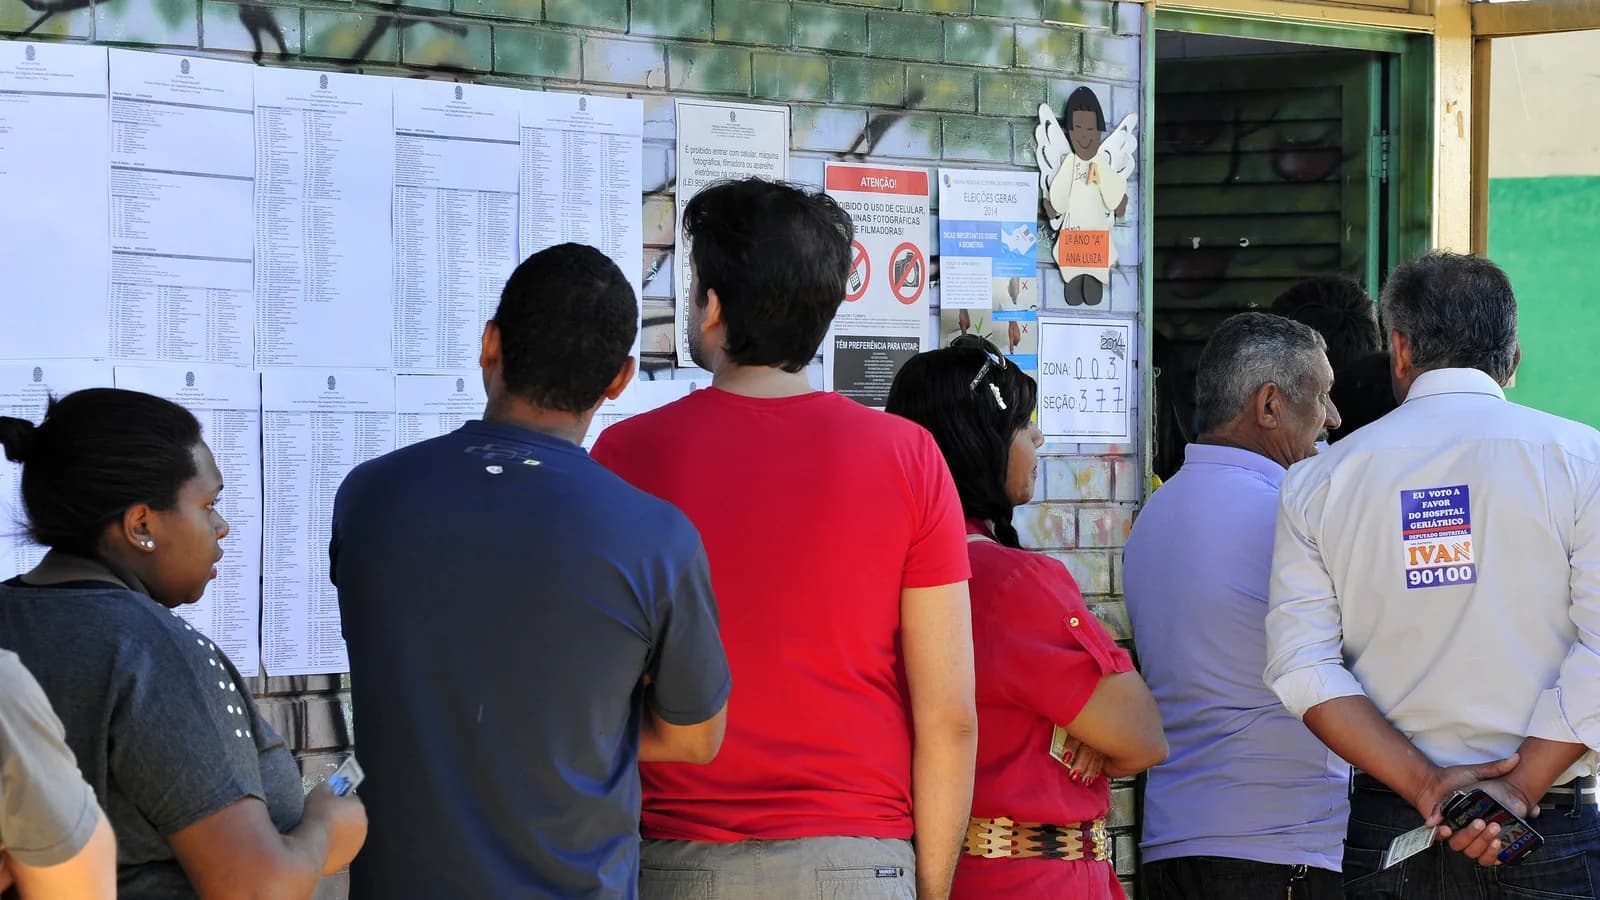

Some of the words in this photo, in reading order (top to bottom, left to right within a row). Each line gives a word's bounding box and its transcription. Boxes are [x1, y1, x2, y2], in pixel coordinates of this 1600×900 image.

[690, 147, 712, 156] proibido
[740, 150, 758, 159] celular,
[759, 151, 780, 160] máquina
[693, 157, 720, 168] fotográfica,
[722, 158, 746, 168] filmadora
[753, 162, 774, 170] aparelho
[694, 168, 720, 177] eletrônico
[860, 176, 896, 190] ATENÇÃO!
[964, 191, 994, 204] ELEIÇÕES
[994, 193, 1017, 204] GERAIS
[864, 202, 870, 211] O
[870, 203, 885, 212] USO
[885, 204, 894, 213] DE
[896, 204, 926, 216] CELULAR,
[984, 206, 998, 216] 2014
[873, 213, 920, 225] FOTOGRÁFICAS
[860, 226, 904, 236] FILMADORAS!
[1074, 234, 1090, 246] ANO
[1066, 252, 1080, 264] ANA
[1082, 252, 1102, 264] LUIZA
[836, 339, 848, 350] TÊM
[848, 340, 886, 350] PREFERÊNCIA
[887, 342, 900, 350] PARA
[900, 342, 919, 351] VOTAR:
[1043, 362, 1070, 376] ZONA:
[1044, 394, 1077, 412] SEÇÃO:
[1428, 489, 1452, 498] VOTO
[1422, 499, 1450, 508] FAVOR
[1422, 508, 1465, 518] HOSPITAL
[1410, 518, 1464, 530] GERIÁTRICO
[1408, 542, 1471, 565] IVAN
[1409, 566, 1472, 585] 90100
